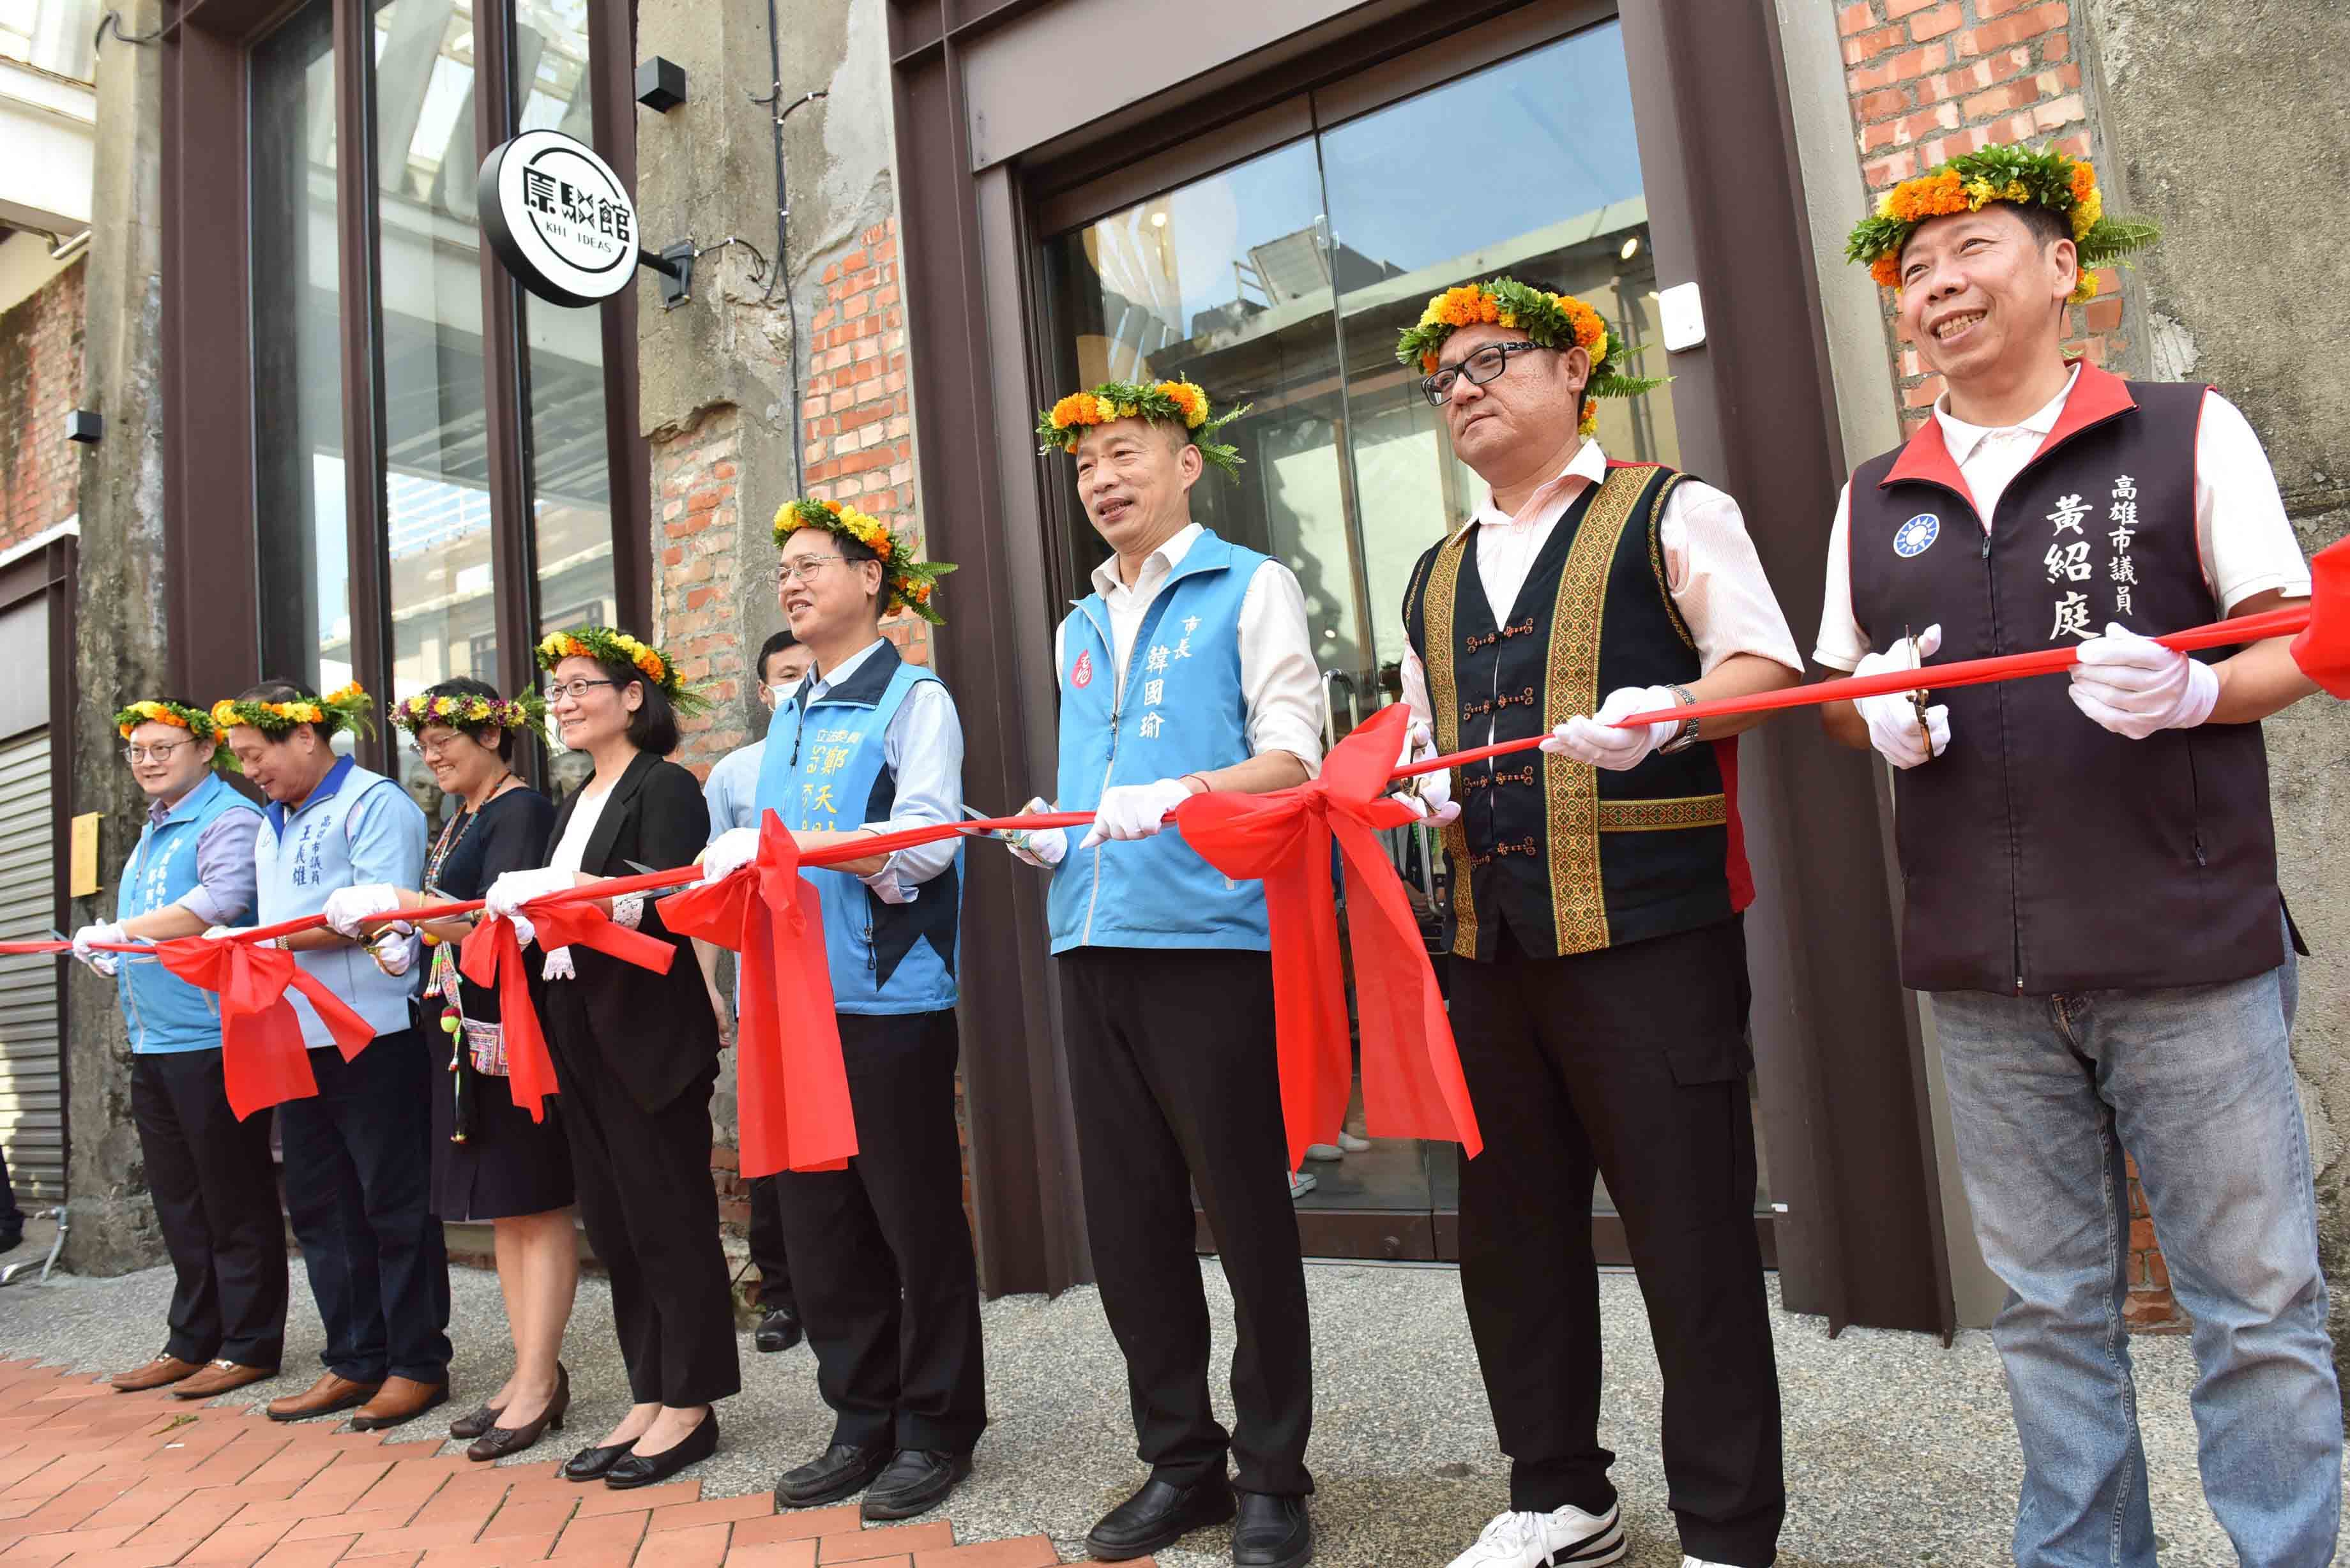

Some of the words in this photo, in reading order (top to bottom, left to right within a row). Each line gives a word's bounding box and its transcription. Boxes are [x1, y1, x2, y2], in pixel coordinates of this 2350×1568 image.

[578, 232, 612, 253] IDEAS
[2043, 494, 2102, 640] 黃紹庭
[2108, 474, 2139, 615] 高雄市議員
[1173, 615, 1202, 660] 市長
[1139, 645, 1171, 739] 韓國瑜
